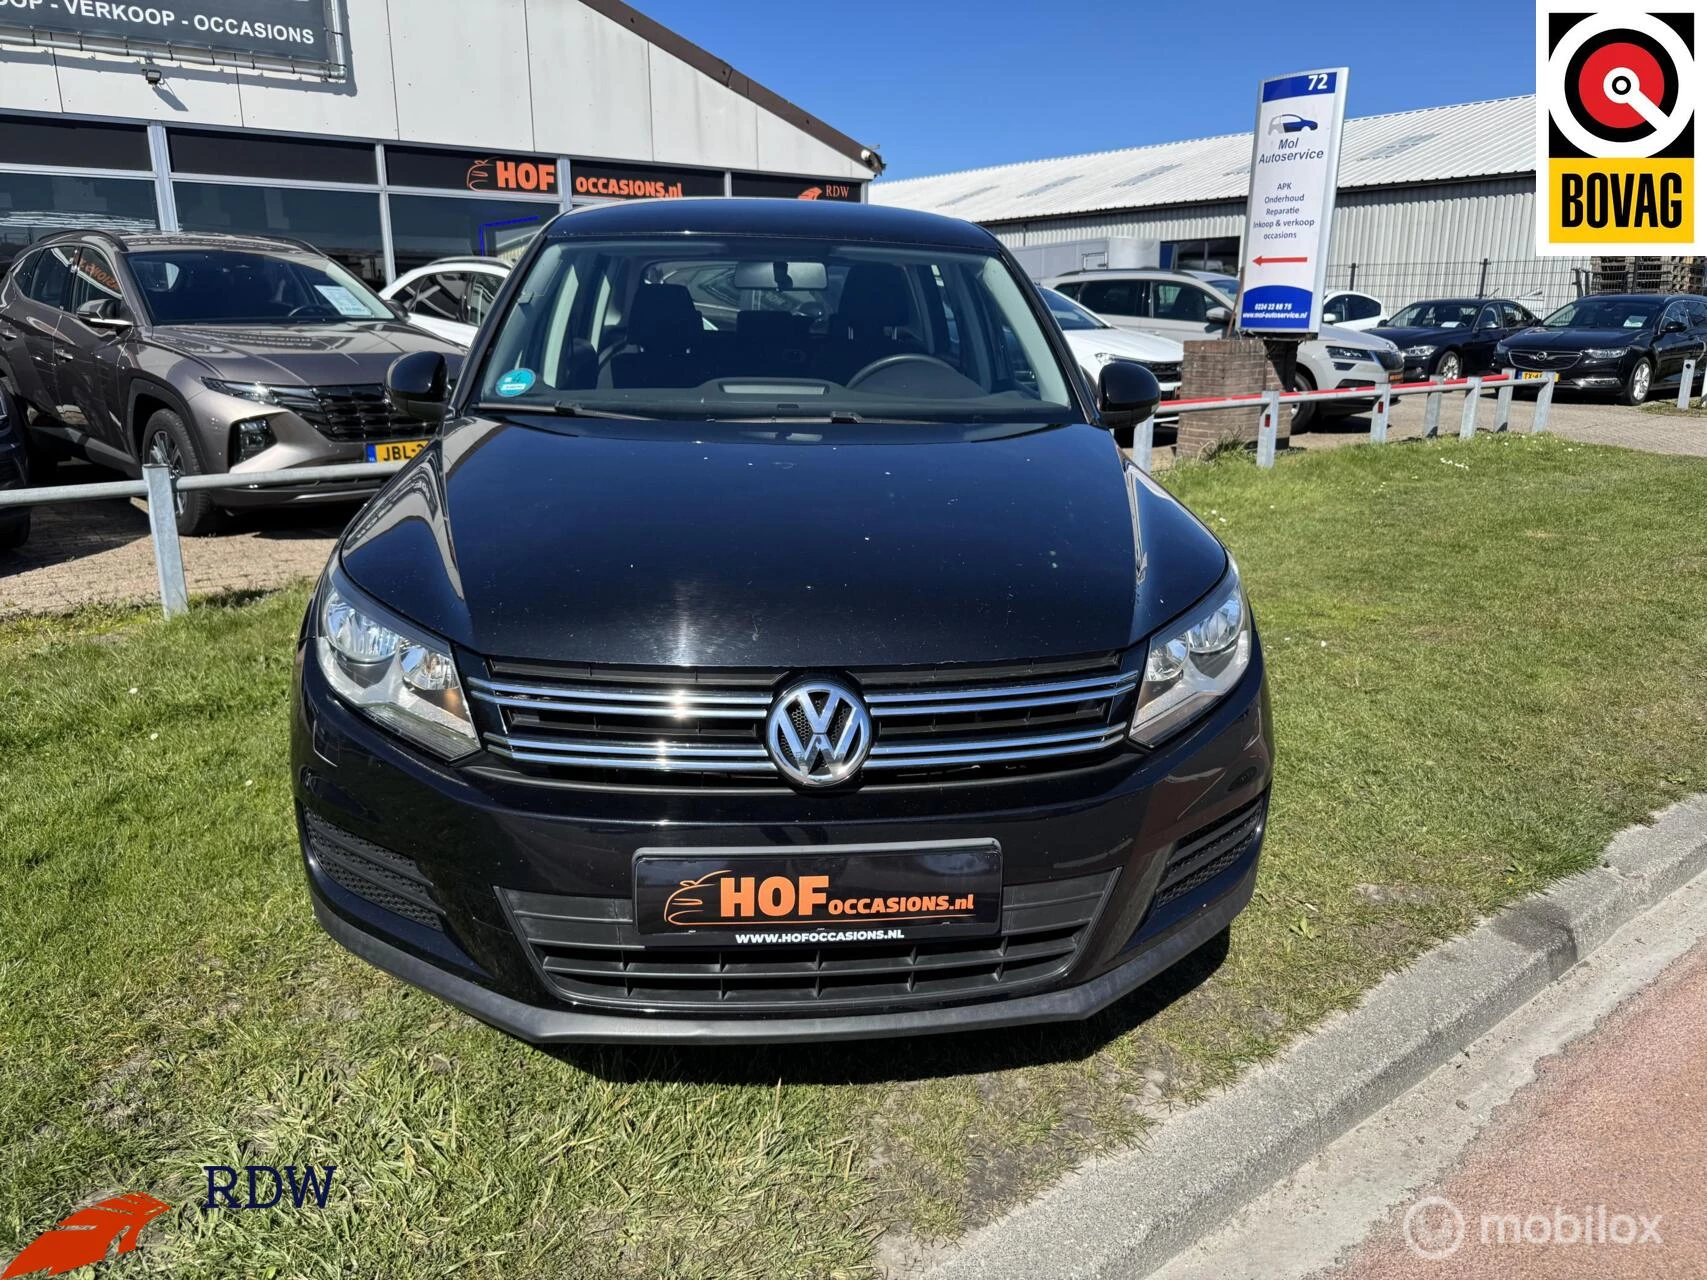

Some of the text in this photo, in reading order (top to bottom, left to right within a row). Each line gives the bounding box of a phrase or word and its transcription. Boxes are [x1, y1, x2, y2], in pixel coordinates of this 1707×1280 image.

[63, 0, 175, 26] VERKOOP
[193, 15, 315, 45] OCCASIONS
[1307, 73, 1328, 91] 72
[1278, 138, 1299, 150] Mol
[1258, 148, 1324, 165] Autoservice
[495, 160, 682, 199] HOF OCCASIONS.nl
[1277, 182, 1292, 190] APK
[825, 184, 849, 198] RDW
[1264, 194, 1304, 204] Onderhoud
[1265, 207, 1300, 216] Reparatie
[1253, 218, 1315, 229] Inkoop & verkoop
[1263, 231, 1297, 240] occasions
[735, 929, 905, 945] WWW.HOFOCCASIONS.NL
